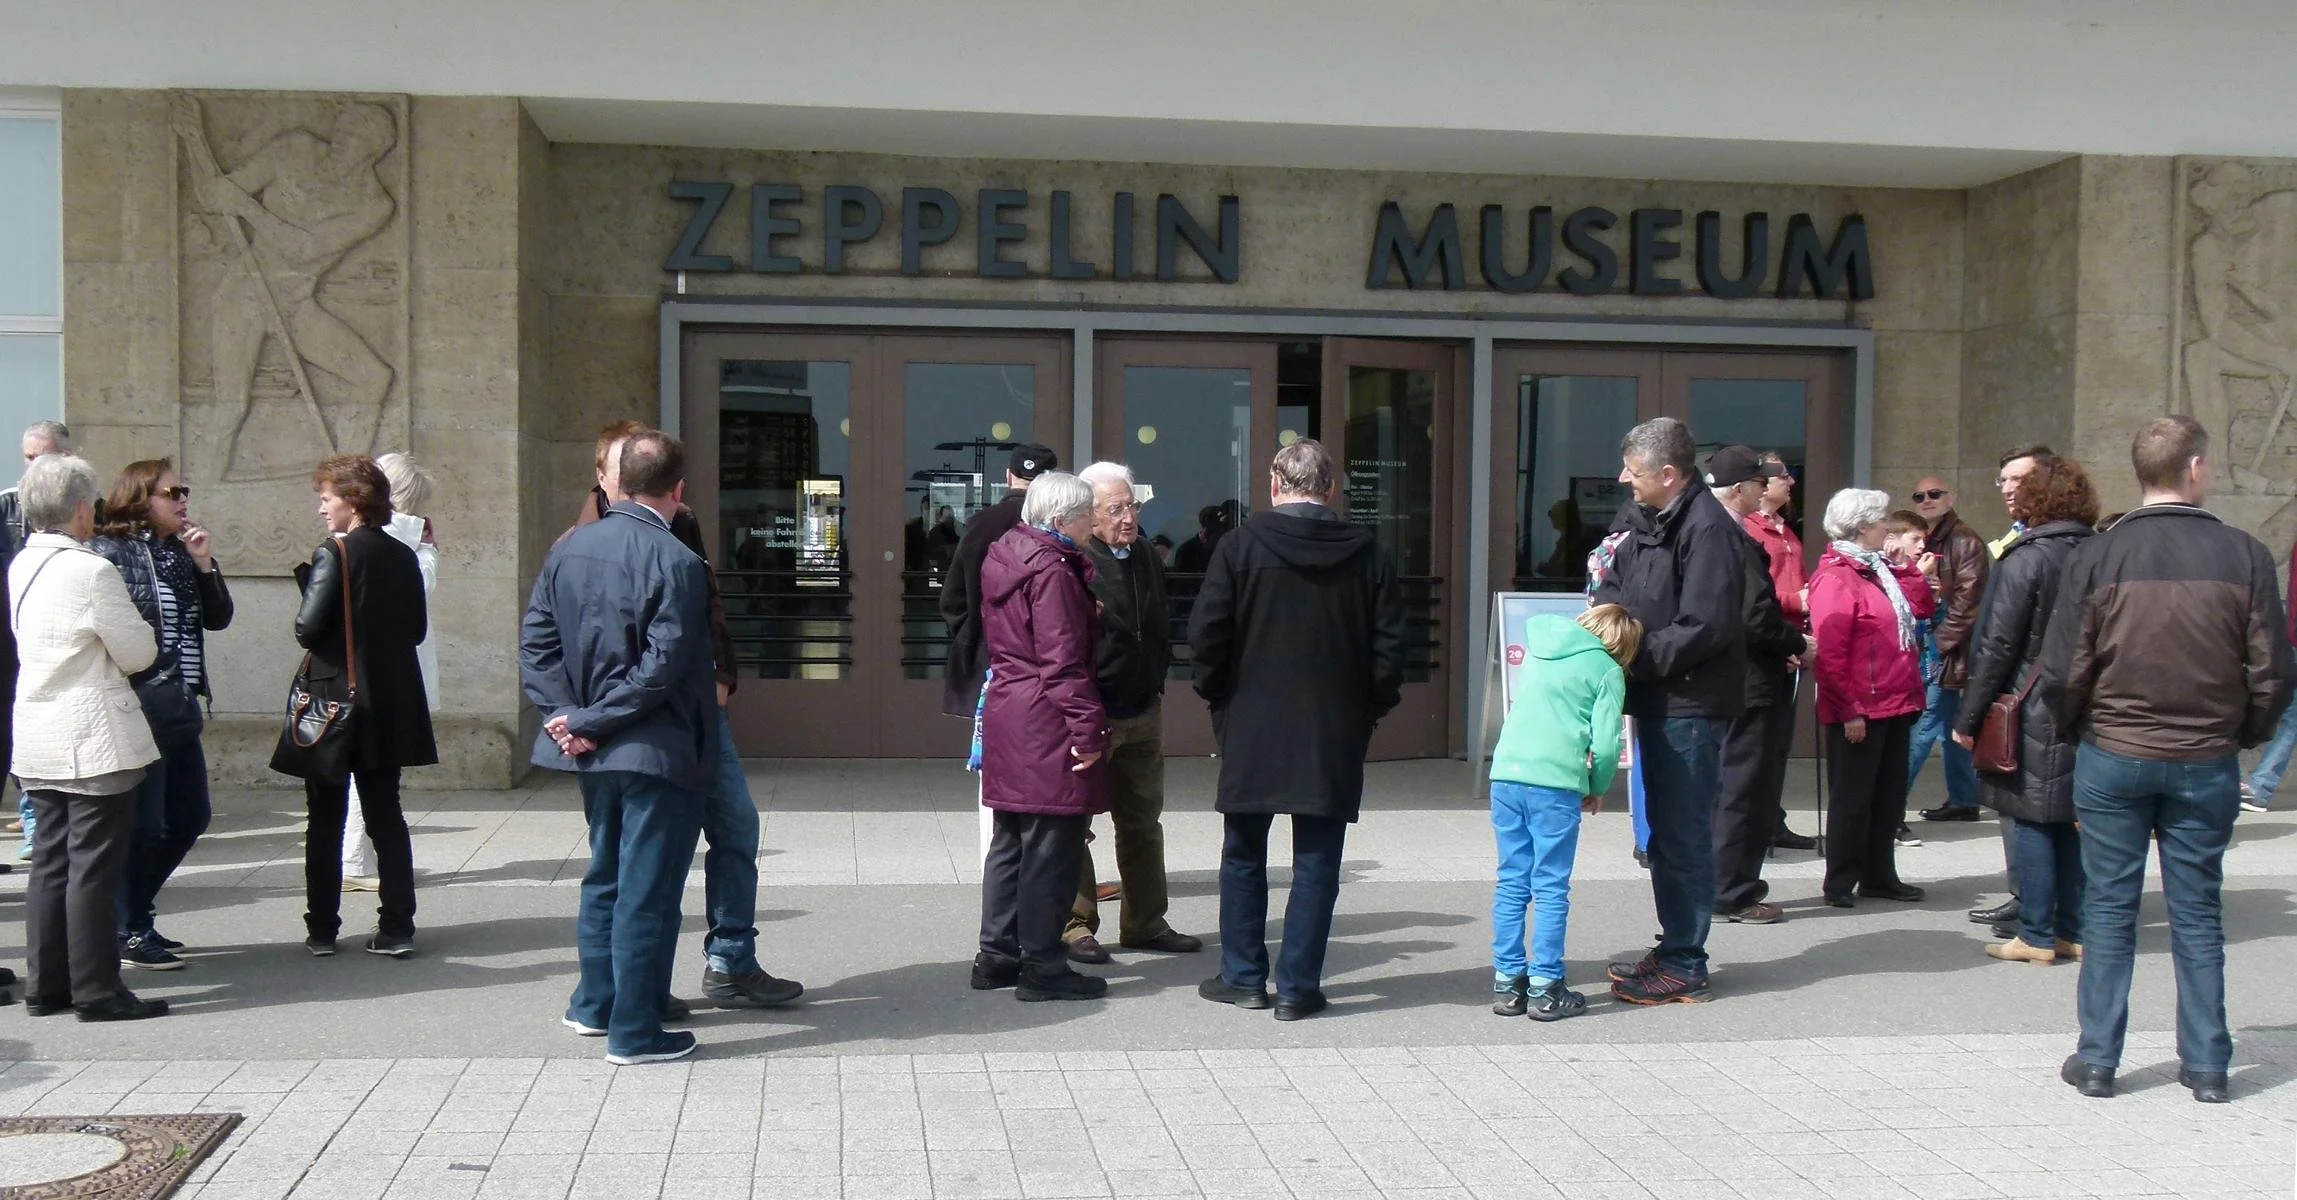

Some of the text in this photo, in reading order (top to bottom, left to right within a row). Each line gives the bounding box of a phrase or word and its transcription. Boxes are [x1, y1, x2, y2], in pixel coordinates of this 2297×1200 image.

[663, 181, 1875, 299] ZEPPELIN MUSEUM
[1381, 460, 1407, 468] MUSEUM
[775, 515, 795, 524] Bitte
[750, 527, 774, 536] keine
